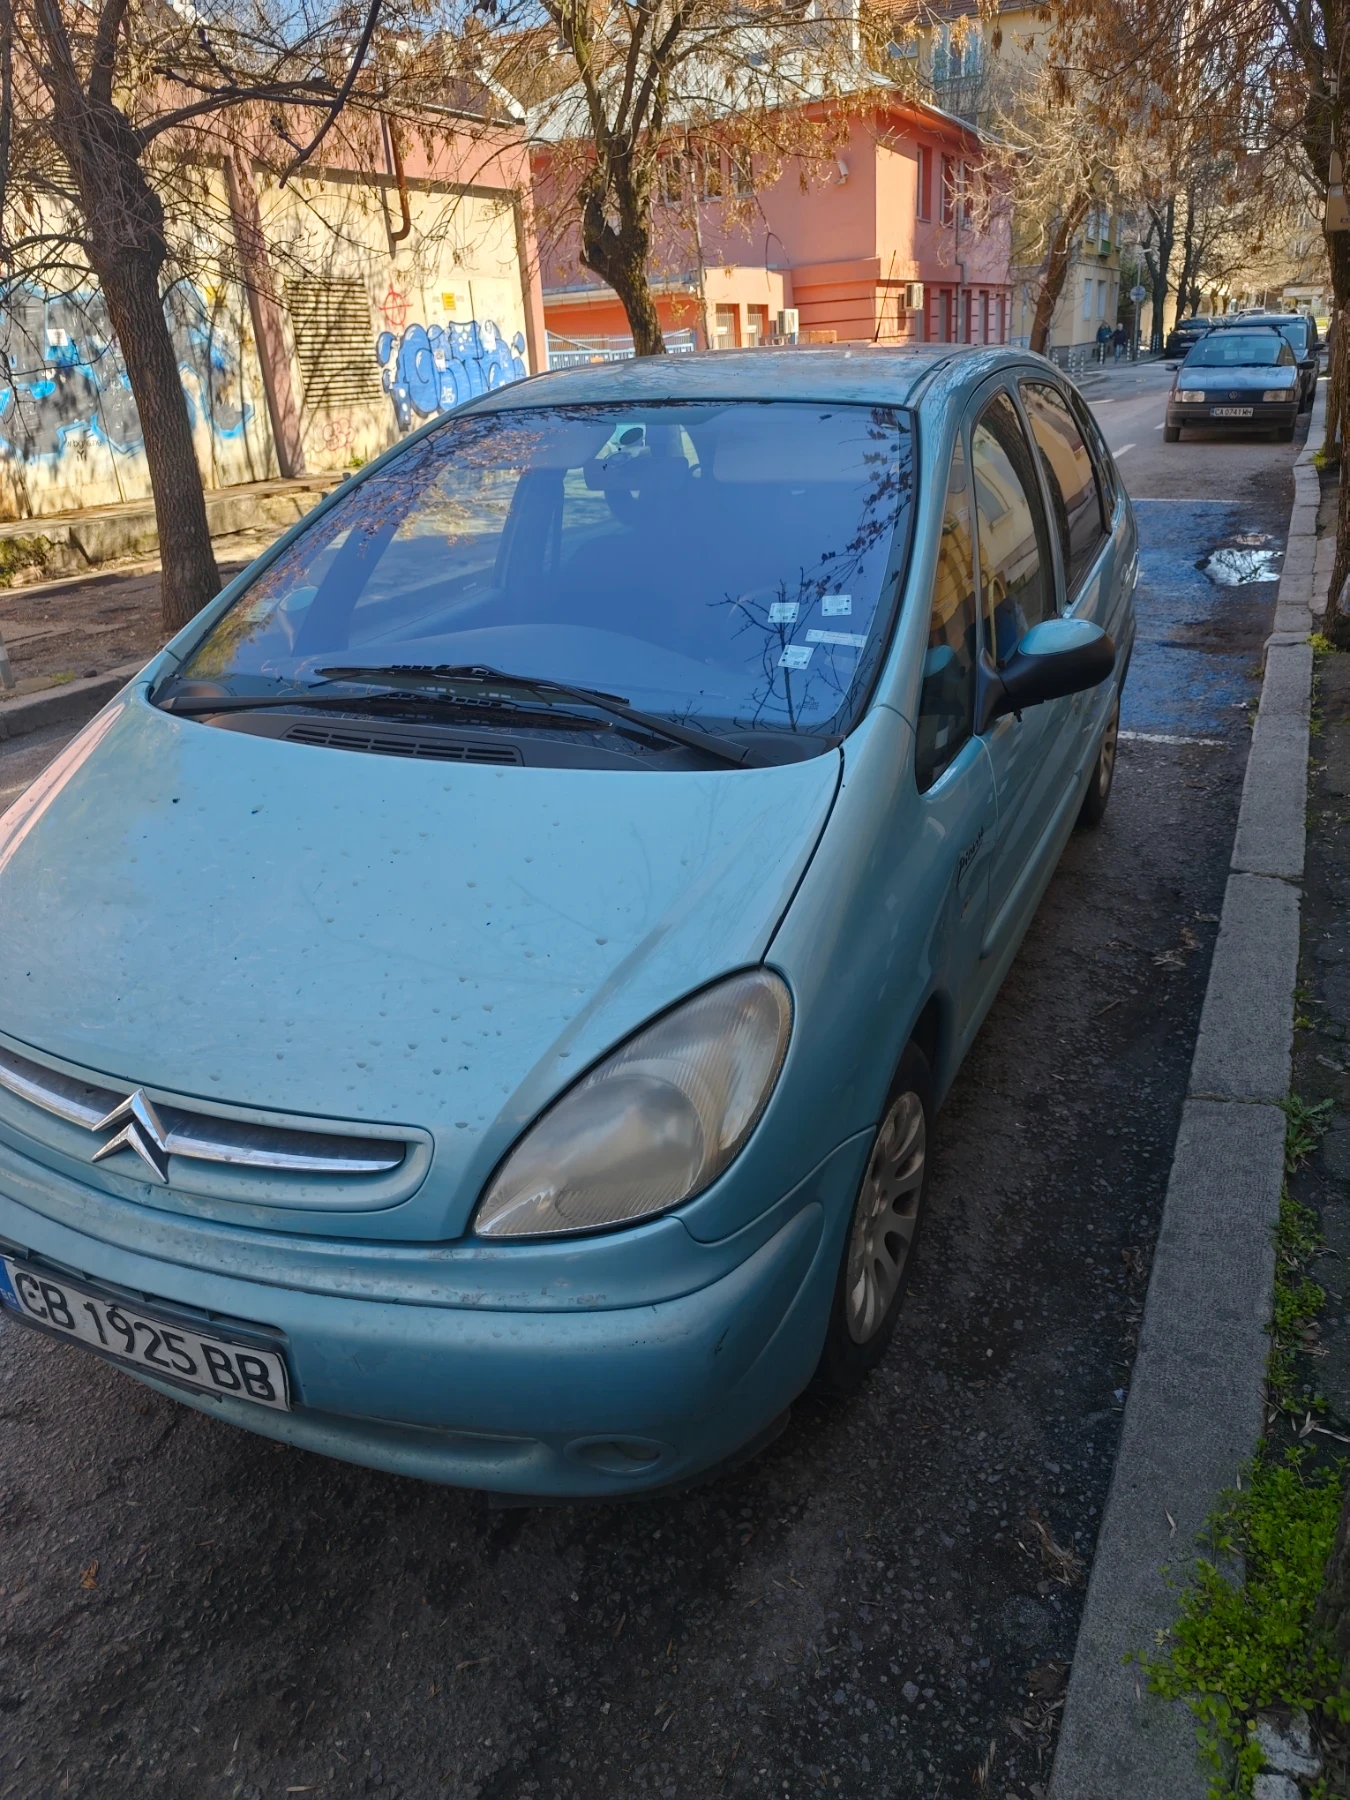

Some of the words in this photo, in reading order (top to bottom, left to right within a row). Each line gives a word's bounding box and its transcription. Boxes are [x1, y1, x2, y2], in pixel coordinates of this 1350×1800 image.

[15, 1272, 76, 1330] CB
[83, 1301, 198, 1376] 1925
[200, 1343, 277, 1402] BB
